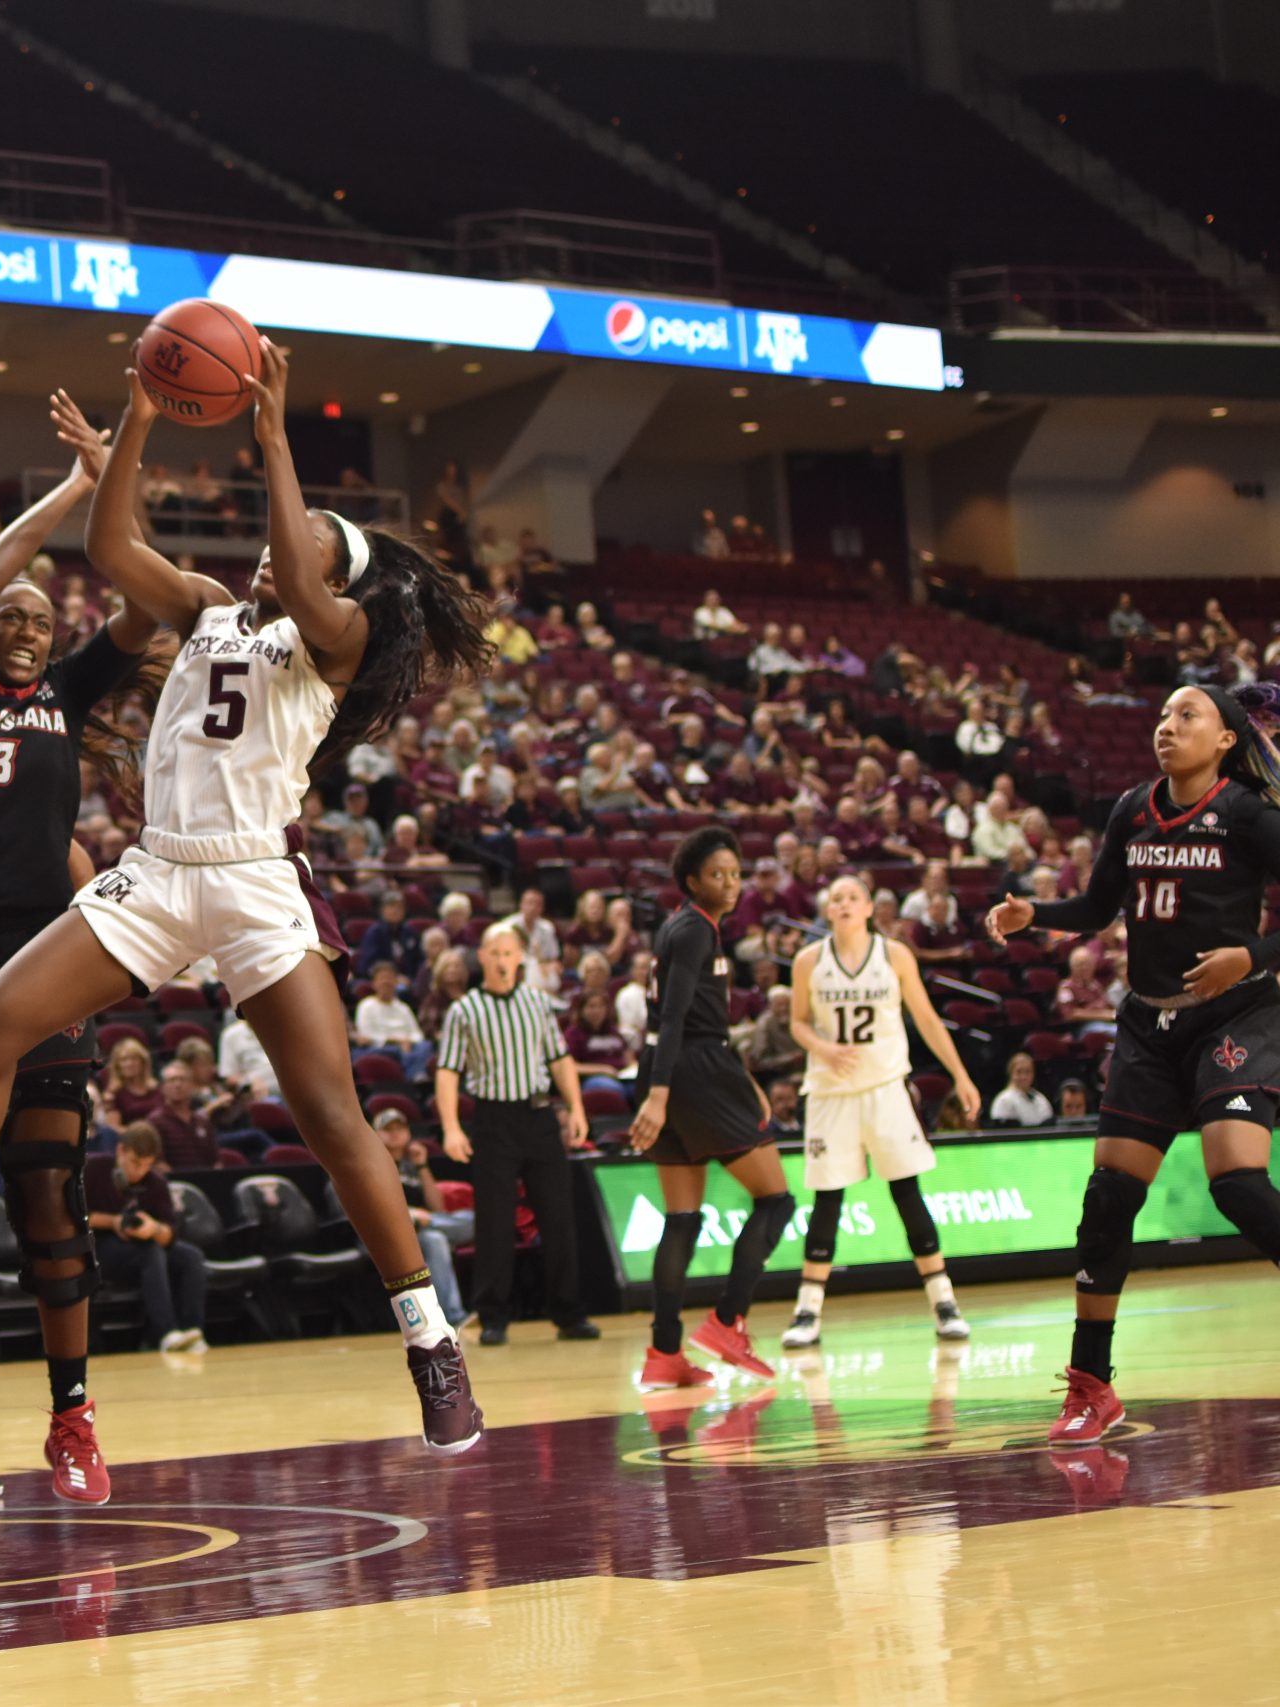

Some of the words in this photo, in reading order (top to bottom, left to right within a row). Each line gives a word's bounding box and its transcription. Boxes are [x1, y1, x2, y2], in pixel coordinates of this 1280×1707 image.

[648, 316, 728, 354] pepsi
[185, 635, 246, 660] TEXAS
[247, 639, 293, 670] A&M
[202, 662, 250, 741] 5
[1136, 878, 1183, 922] 10
[835, 1006, 876, 1045] 12
